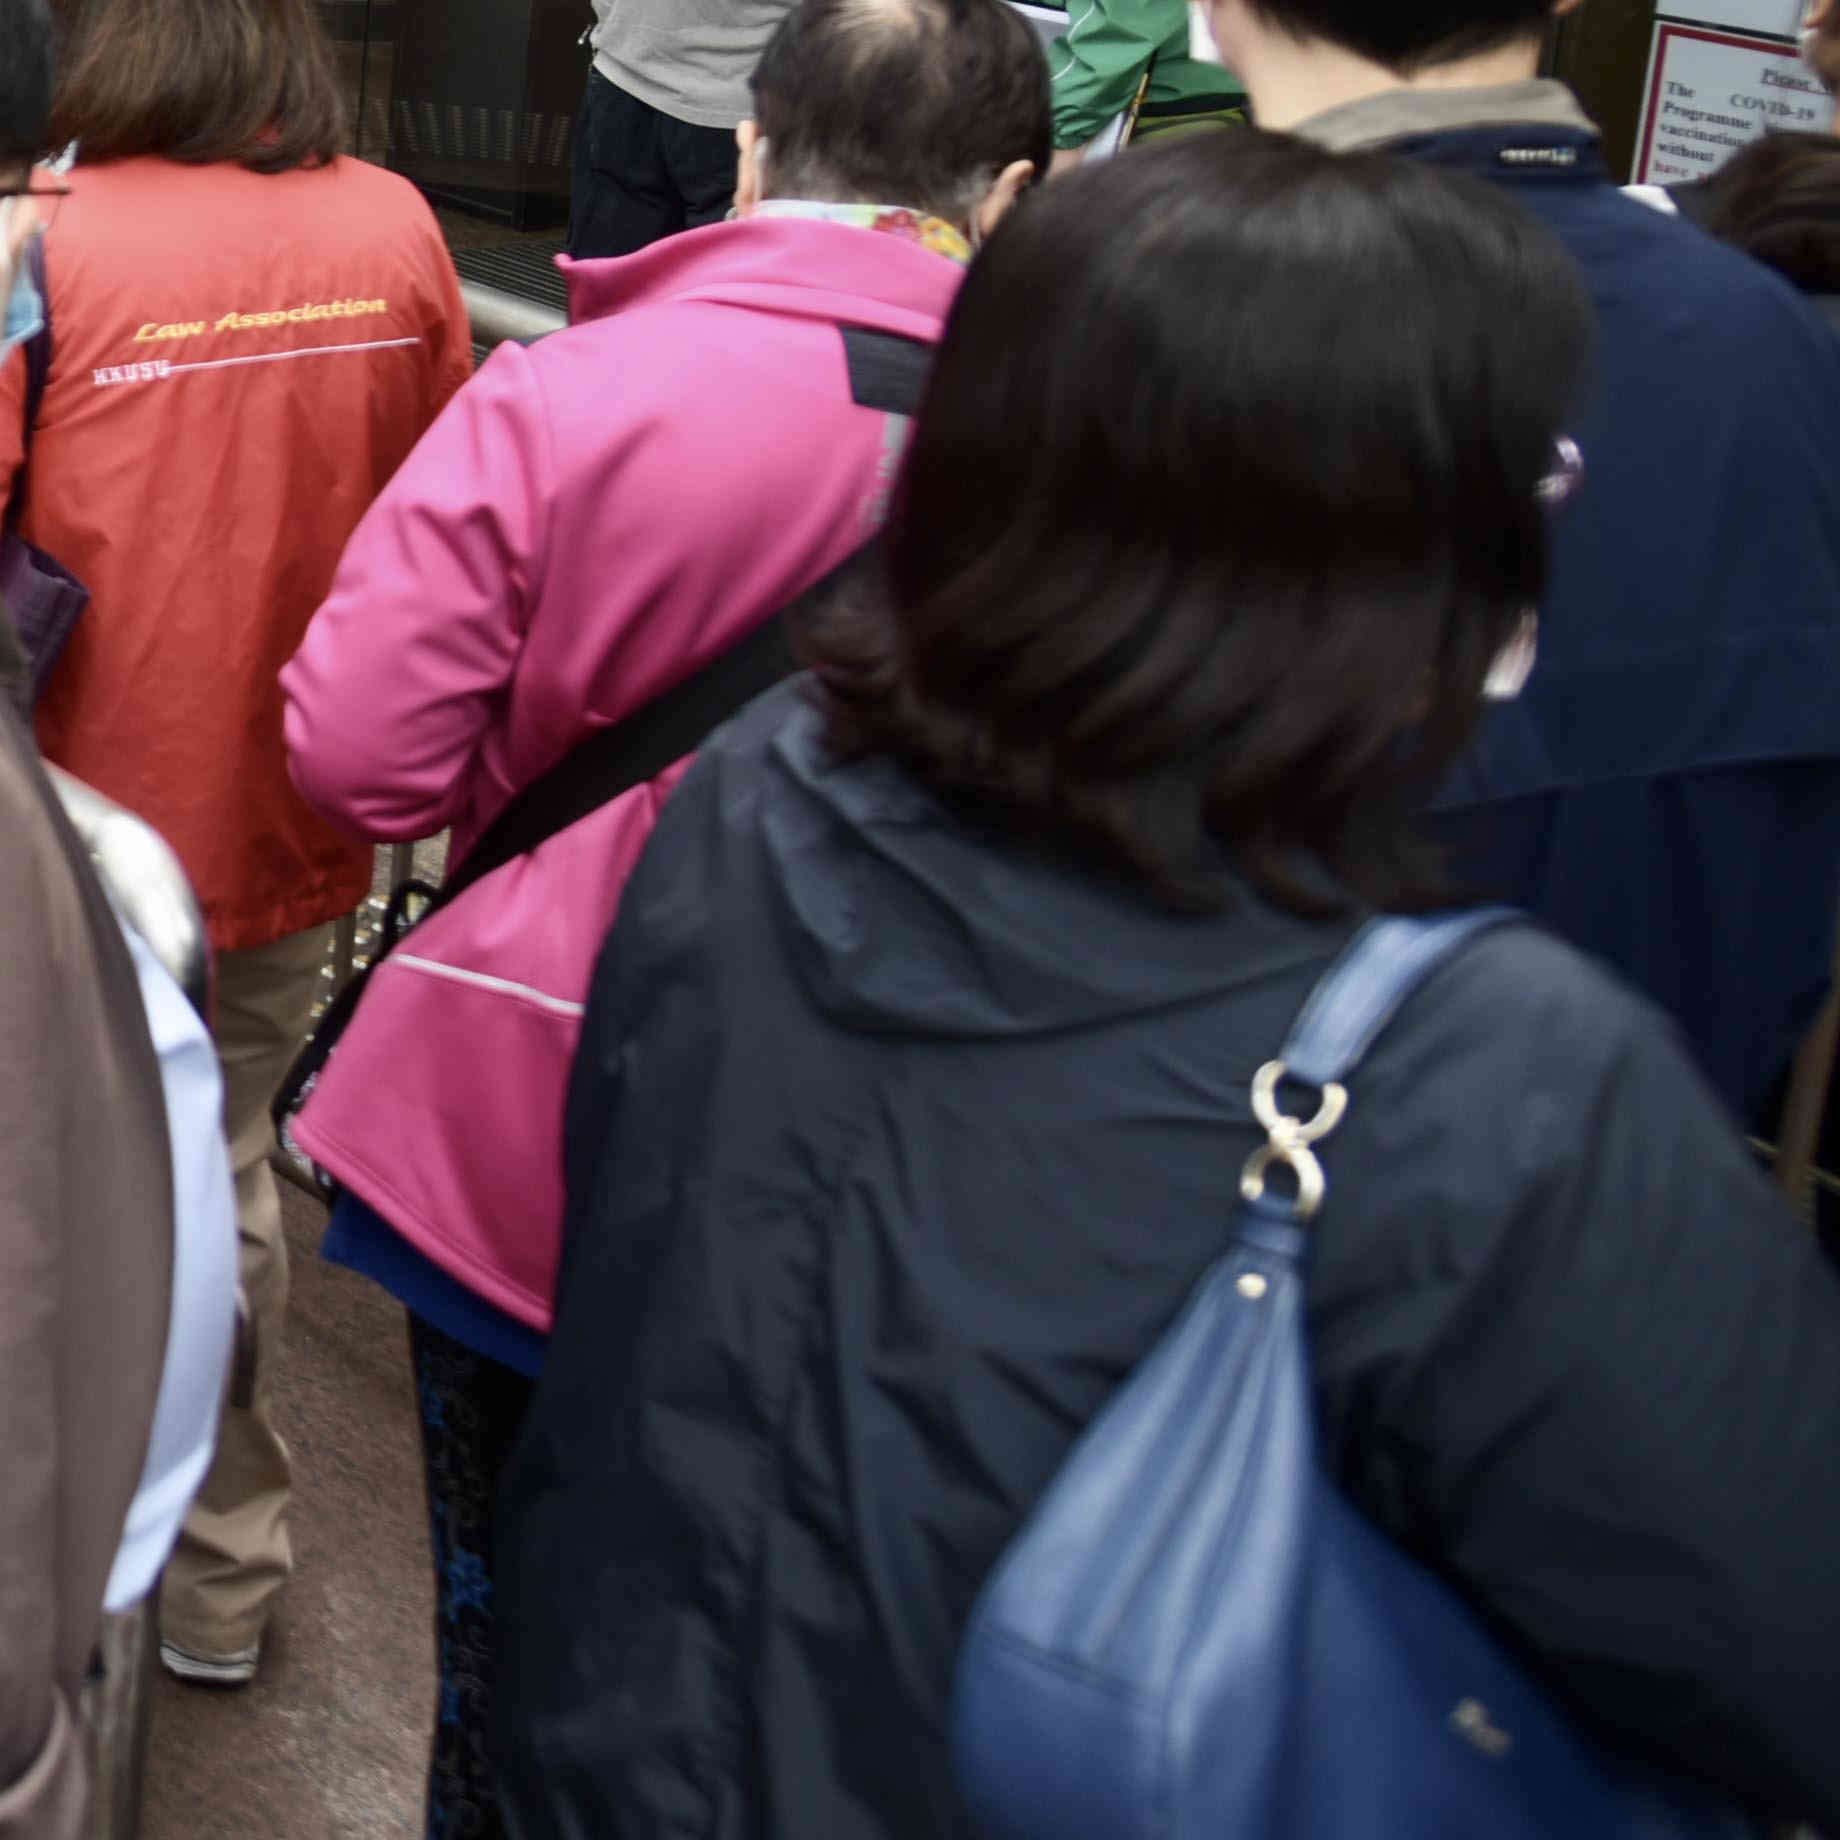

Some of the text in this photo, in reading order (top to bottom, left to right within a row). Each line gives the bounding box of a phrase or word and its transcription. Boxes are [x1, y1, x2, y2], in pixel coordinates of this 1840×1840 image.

[1663, 100, 1754, 130] Programme
[1667, 81, 1816, 120] The COVID-19
[1656, 143, 1716, 162] without
[131, 296, 388, 343] Law Association
